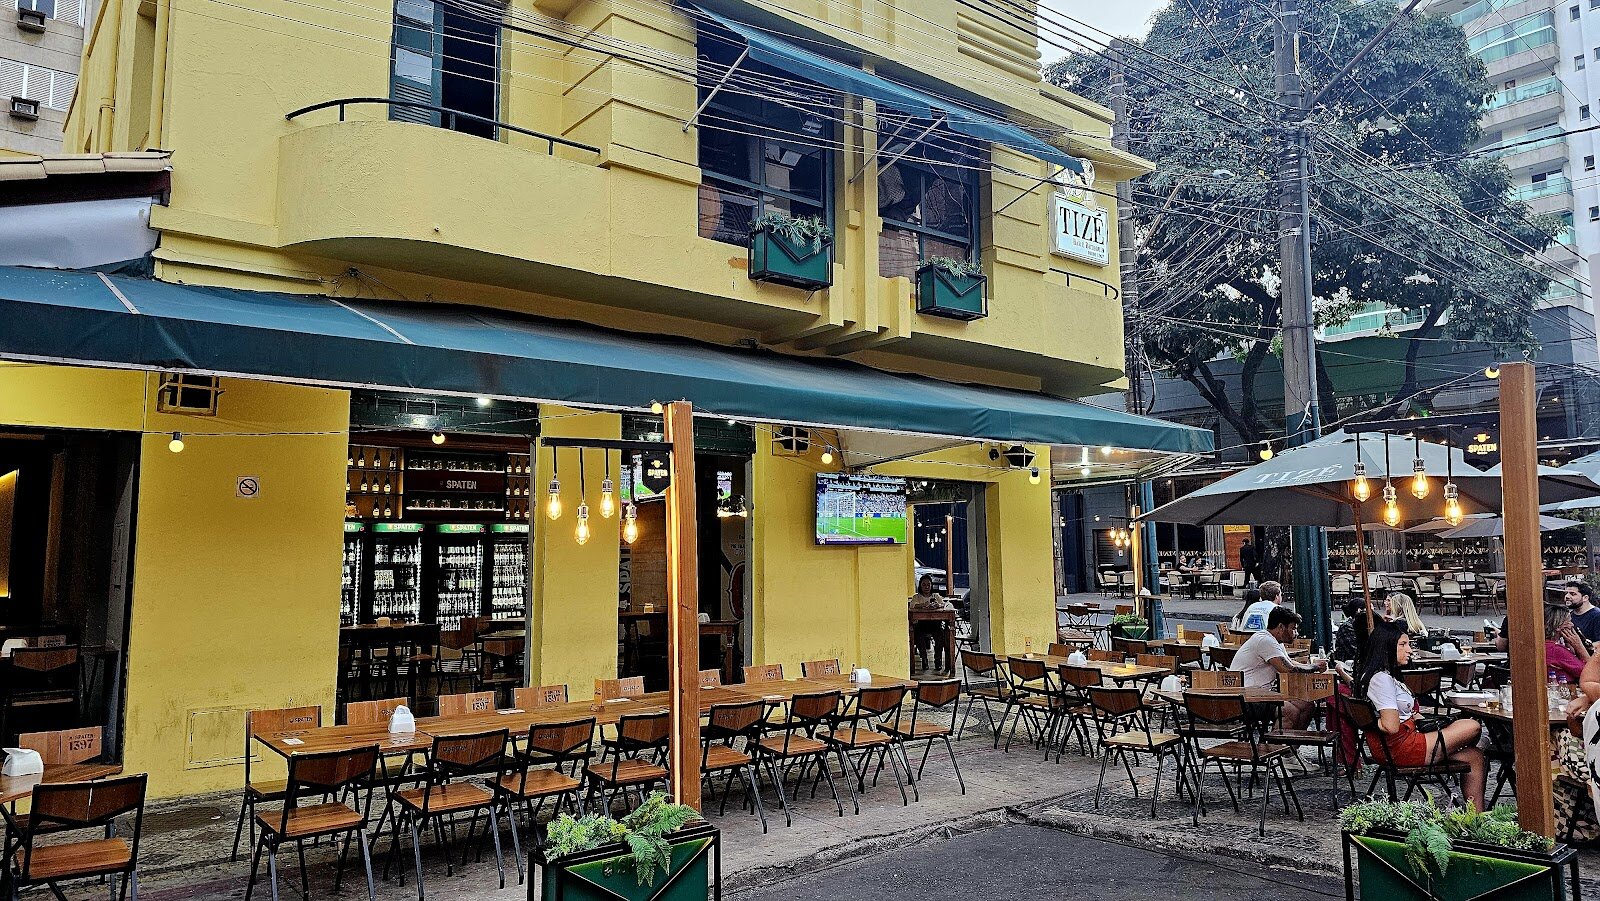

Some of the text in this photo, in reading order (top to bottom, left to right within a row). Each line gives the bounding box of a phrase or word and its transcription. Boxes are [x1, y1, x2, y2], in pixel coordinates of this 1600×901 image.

[1059, 206, 1104, 245] TIZÉ
[1468, 443, 1497, 453] SPATEN
[1253, 463, 1343, 484] TIZÉ
[446, 480, 477, 490] SPATEN
[69, 739, 94, 751] 1397
